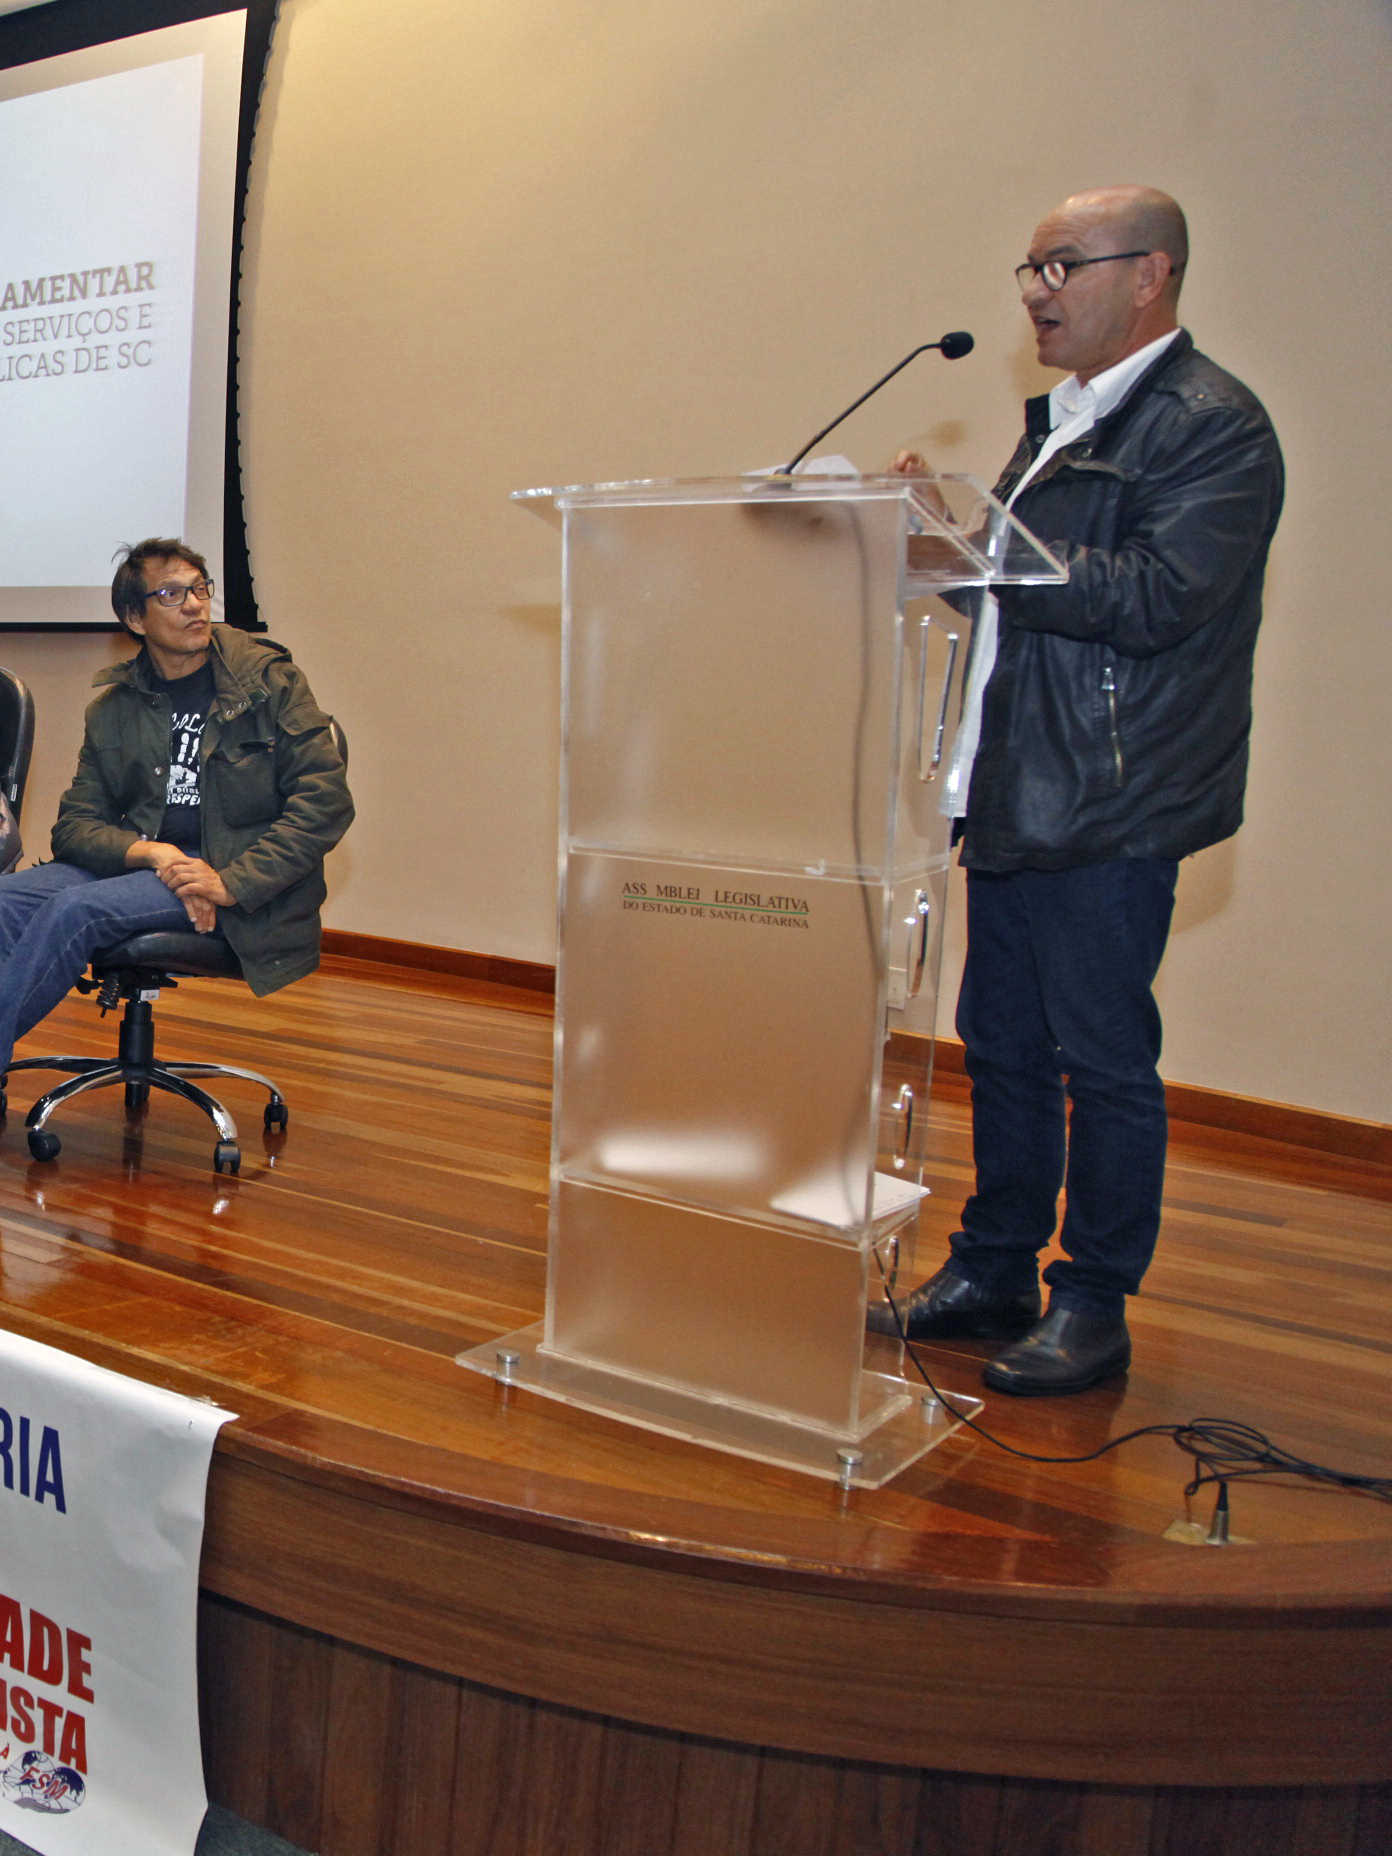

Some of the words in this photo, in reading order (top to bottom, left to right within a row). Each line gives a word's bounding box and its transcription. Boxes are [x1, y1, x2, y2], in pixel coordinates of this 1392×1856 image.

[2, 303, 129, 346] SERVIÇOS
[136, 303, 153, 330] E
[72, 345, 109, 374] DE
[116, 339, 152, 369] SC
[623, 900, 639, 911] DO
[642, 902, 687, 916] ESTADO
[691, 906, 707, 918] DE
[709, 908, 746, 922] SANTA
[750, 913, 809, 929] CATARINA
[714, 889, 809, 913] LEGISLATIVA
[18, 1766, 69, 1800] FSM
